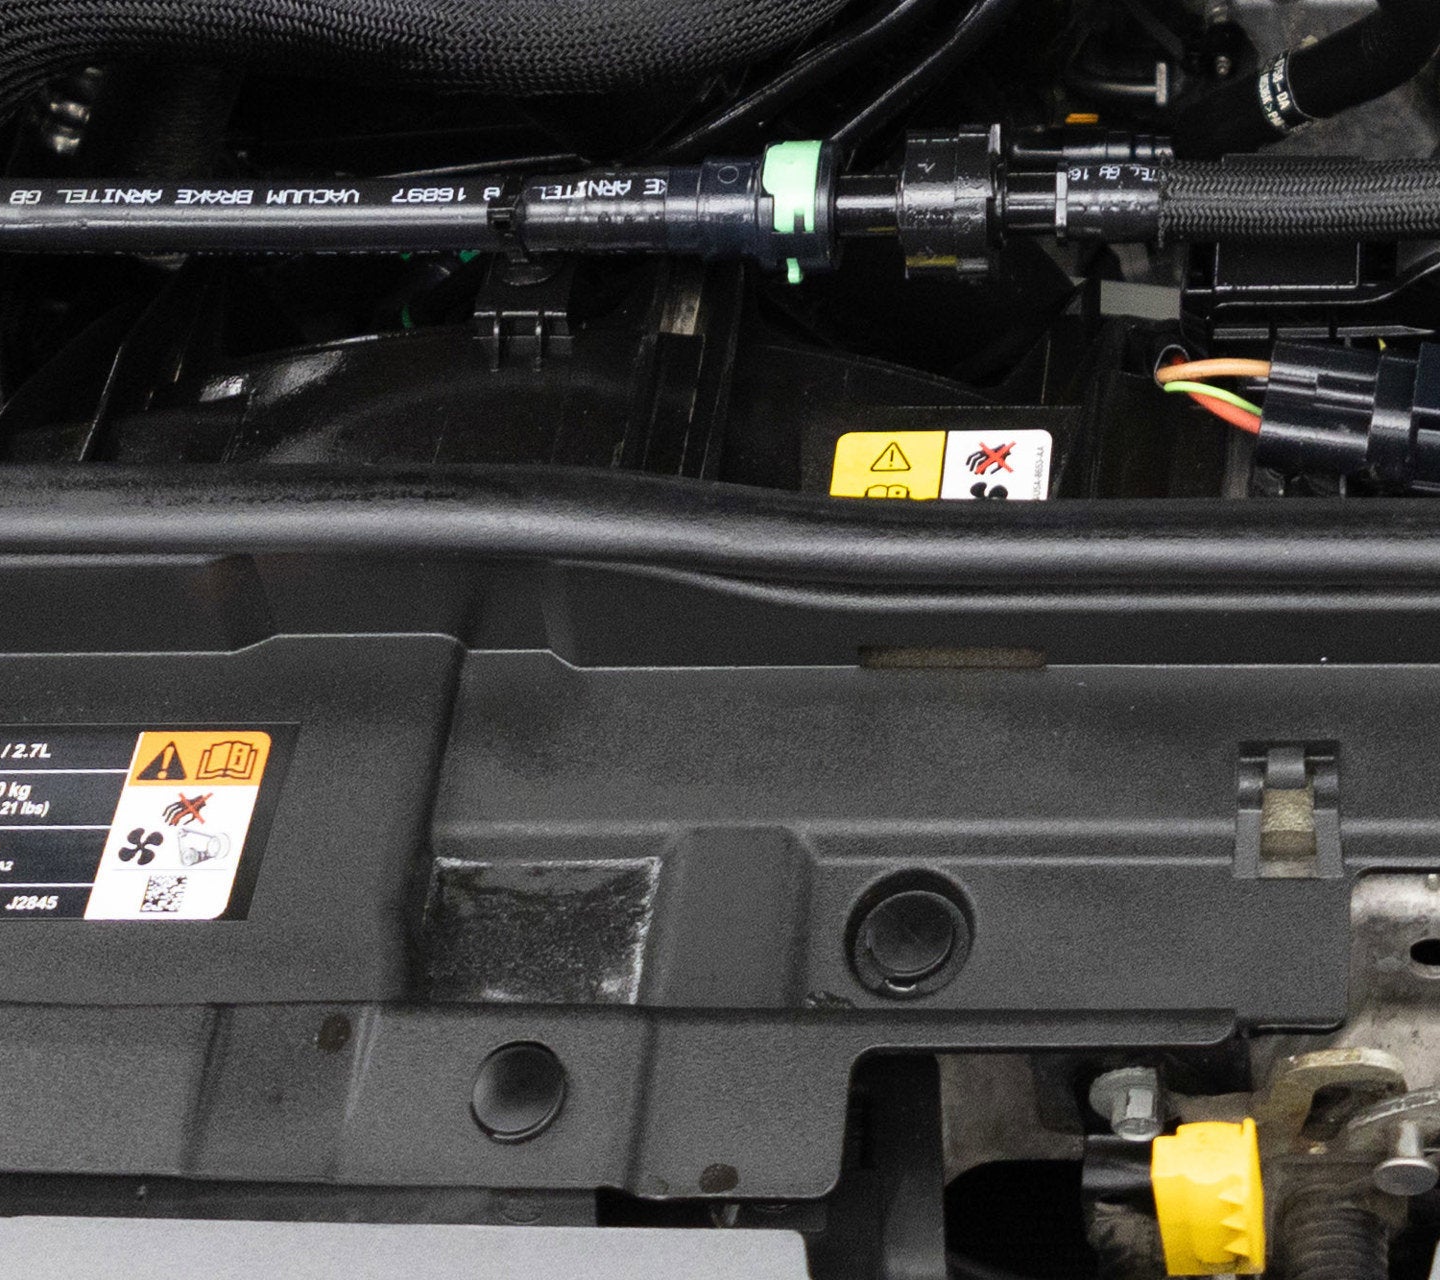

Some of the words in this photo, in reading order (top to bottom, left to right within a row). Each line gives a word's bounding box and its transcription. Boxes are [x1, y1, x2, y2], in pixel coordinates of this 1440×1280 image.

[8, 189, 42, 205] GB
[58, 188, 163, 204] ARNITEL
[174, 188, 254, 204] BRAKE
[266, 188, 360, 204] VACUUM
[391, 187, 467, 204] 16897
[11, 743, 52, 758] 2.7L
[7, 782, 32, 801] kg
[19, 801, 50, 818] lbs)
[5, 896, 59, 912] J2845
